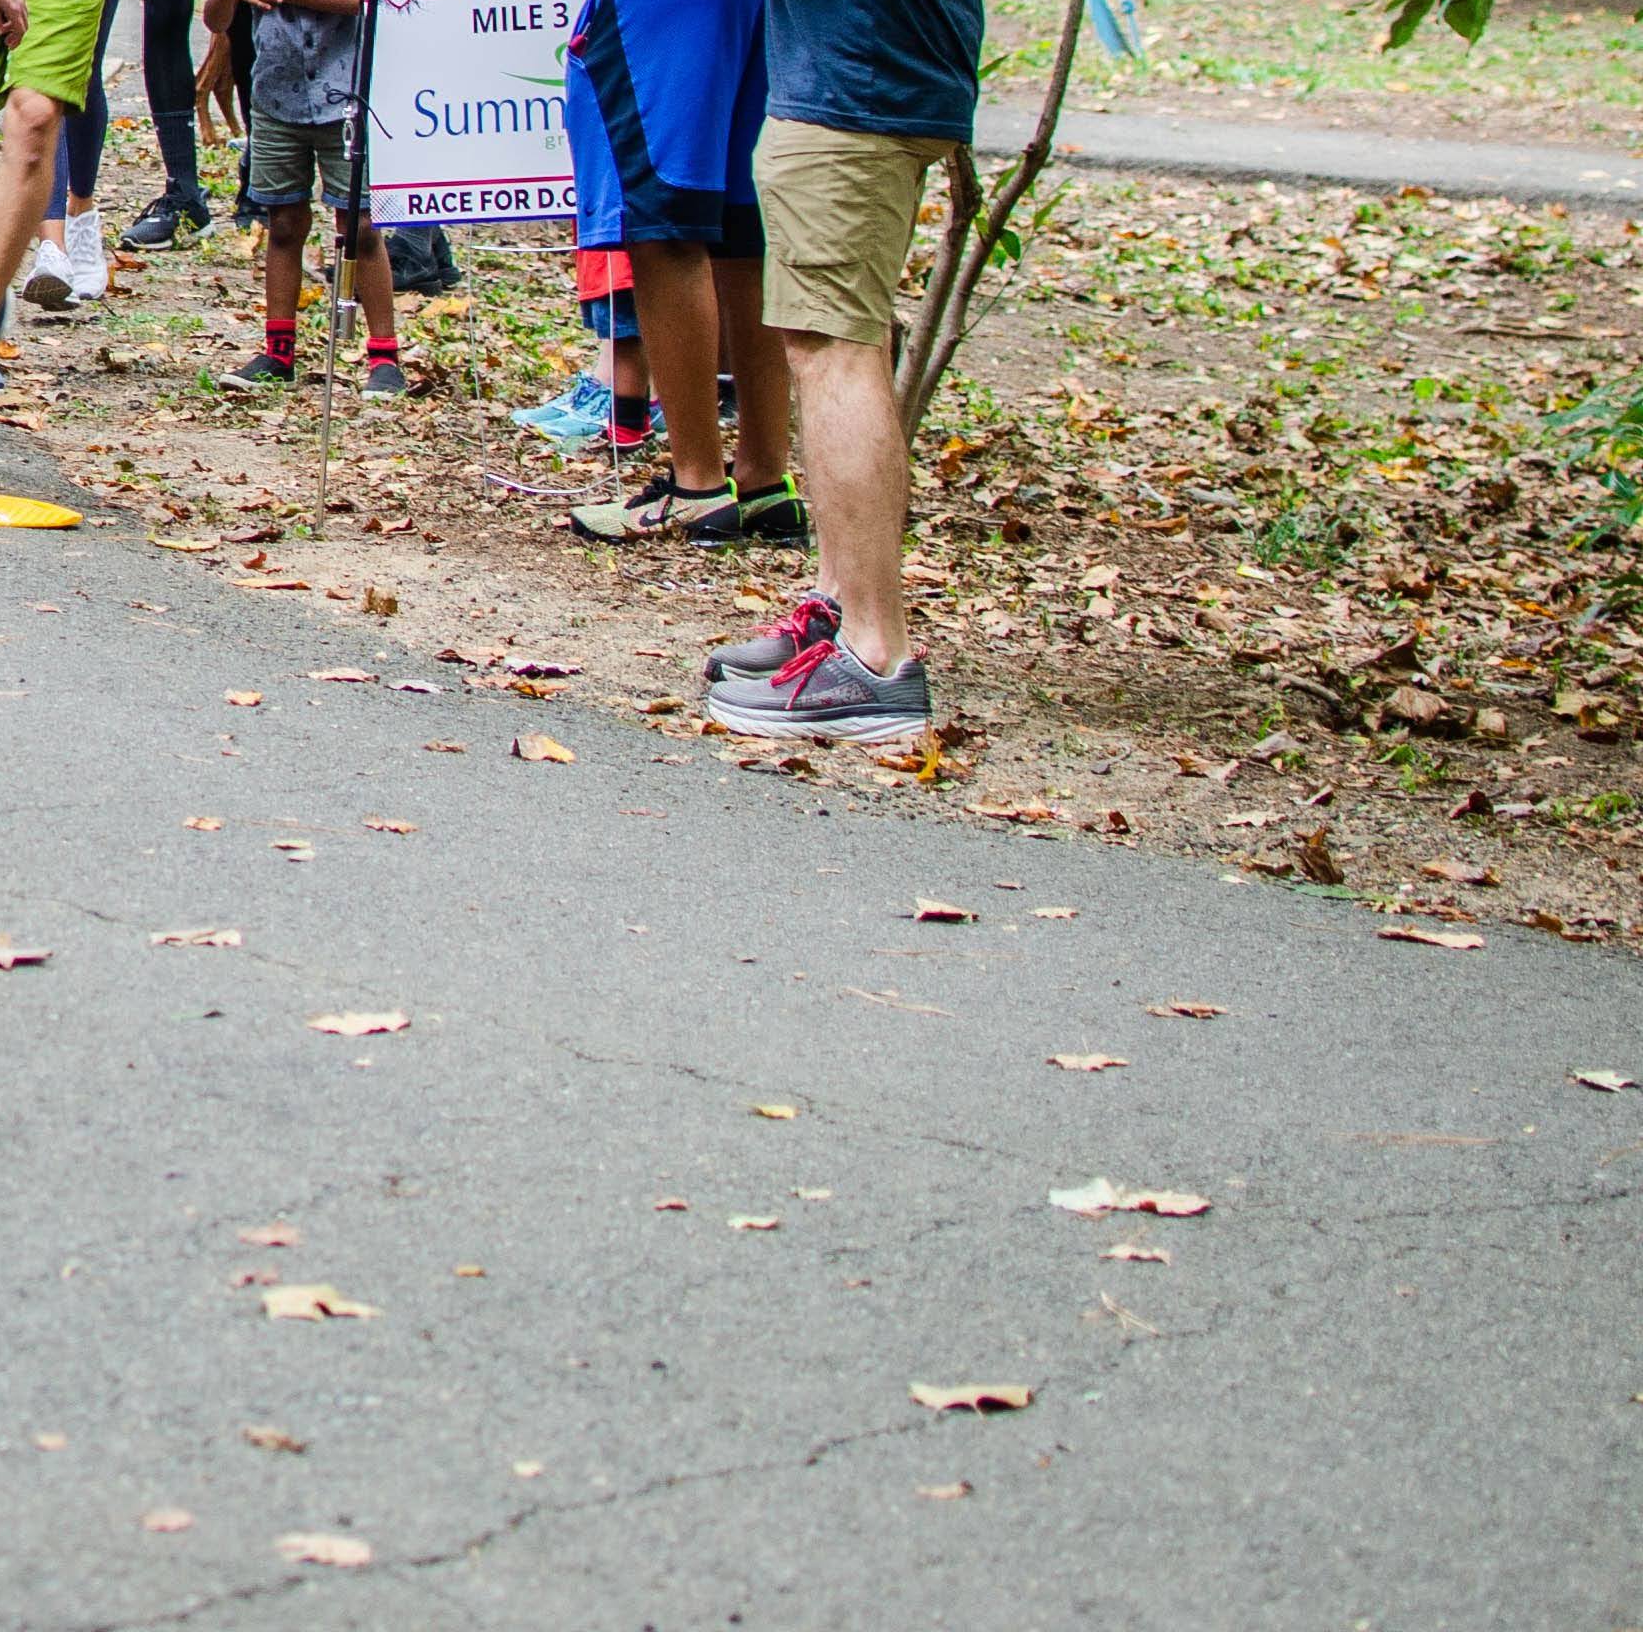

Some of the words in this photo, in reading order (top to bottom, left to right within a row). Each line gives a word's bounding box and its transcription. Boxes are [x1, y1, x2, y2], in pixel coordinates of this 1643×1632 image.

[472, 4, 543, 34] MILE
[552, 2, 569, 29] 3
[408, 191, 473, 215] RACE
[480, 188, 531, 212] FOR
